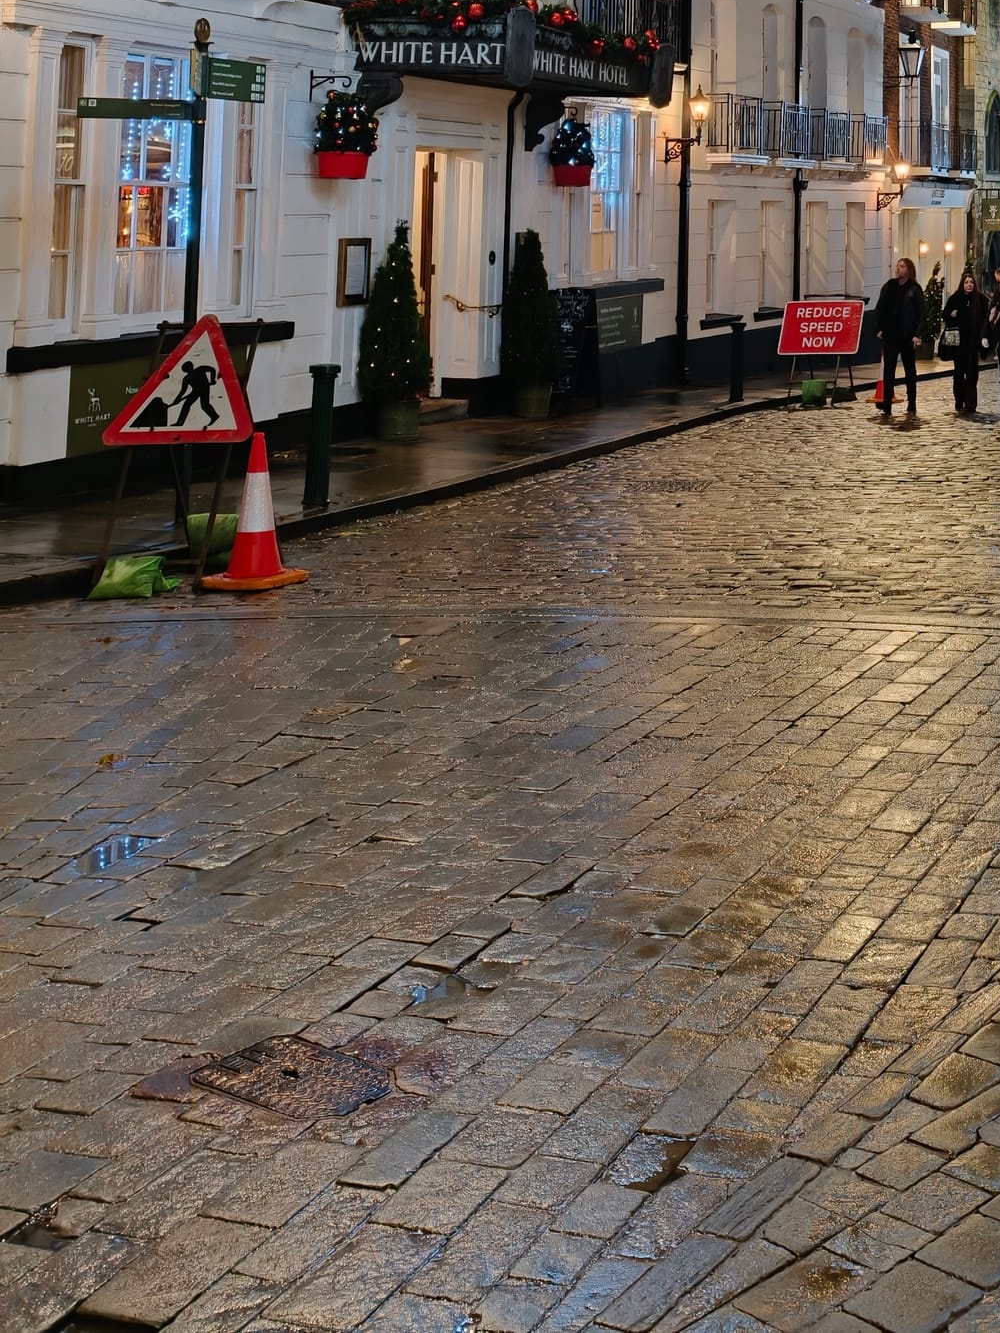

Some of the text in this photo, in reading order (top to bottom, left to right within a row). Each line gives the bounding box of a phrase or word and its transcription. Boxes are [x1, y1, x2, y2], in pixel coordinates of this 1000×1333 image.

[359, 41, 506, 65] WHITE HART
[533, 49, 629, 86] WHITE HART HOTEL
[796, 307, 852, 318] REDUCE
[799, 322, 843, 333] SPEED
[801, 337, 836, 348] NOW
[75, 413, 111, 424] WHITE HART
